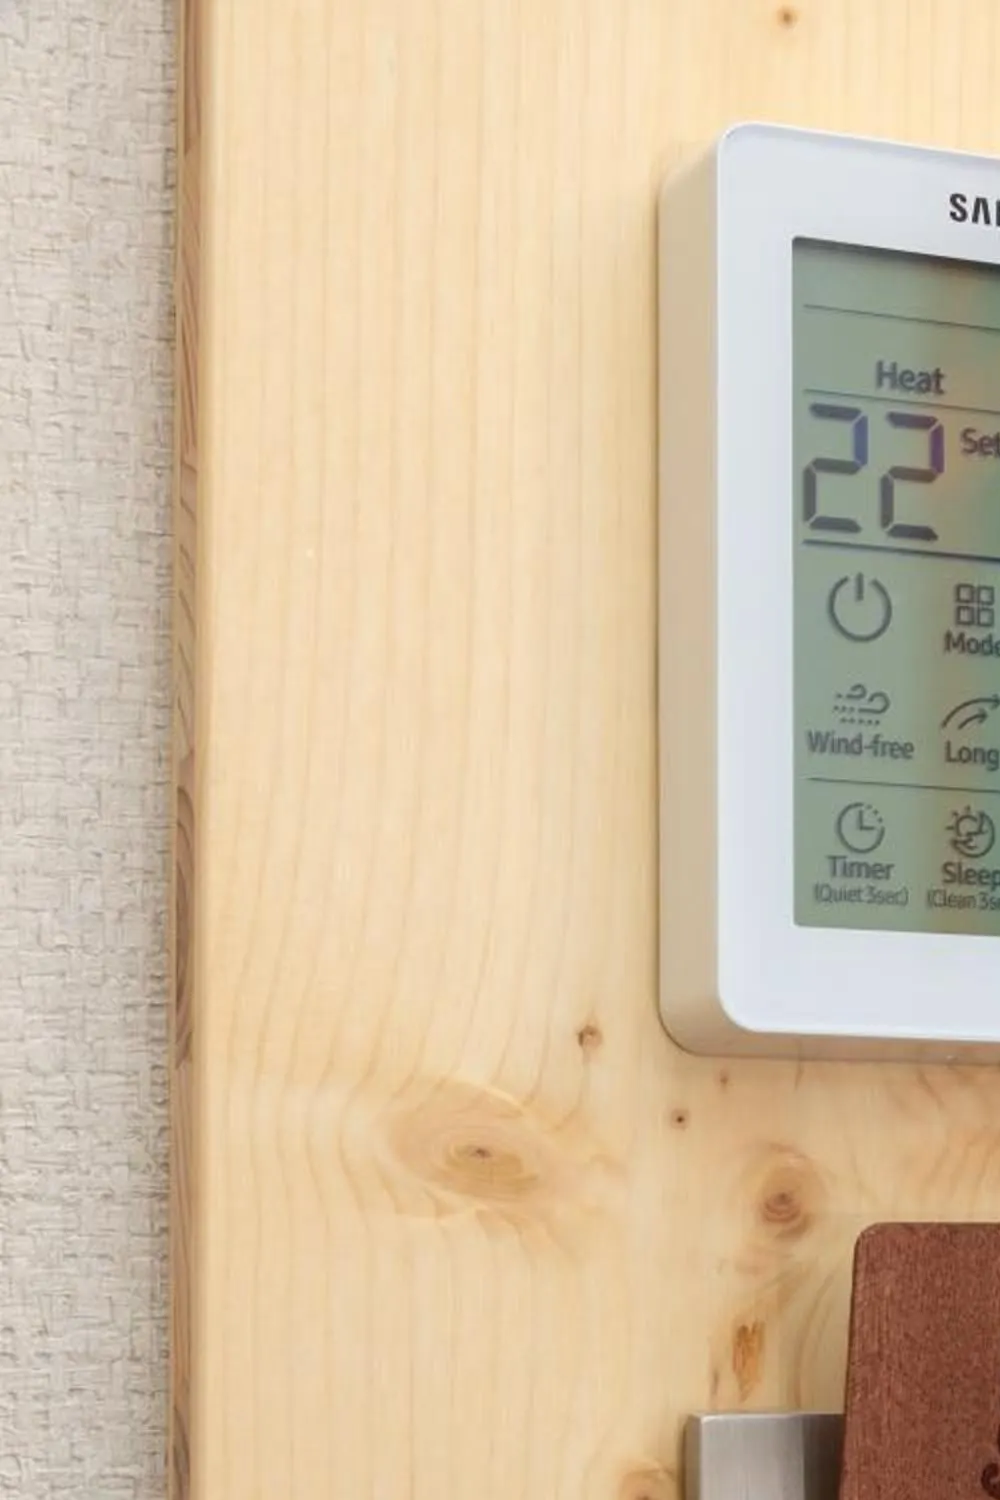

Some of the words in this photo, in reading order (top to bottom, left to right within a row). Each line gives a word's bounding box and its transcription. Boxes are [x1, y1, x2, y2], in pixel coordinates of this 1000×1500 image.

[876, 360, 946, 396] Heat
[803, 403, 945, 542] 22
[807, 730, 914, 759] Wind-free
[945, 740, 1000, 771] Long
[827, 854, 895, 880] Timer
